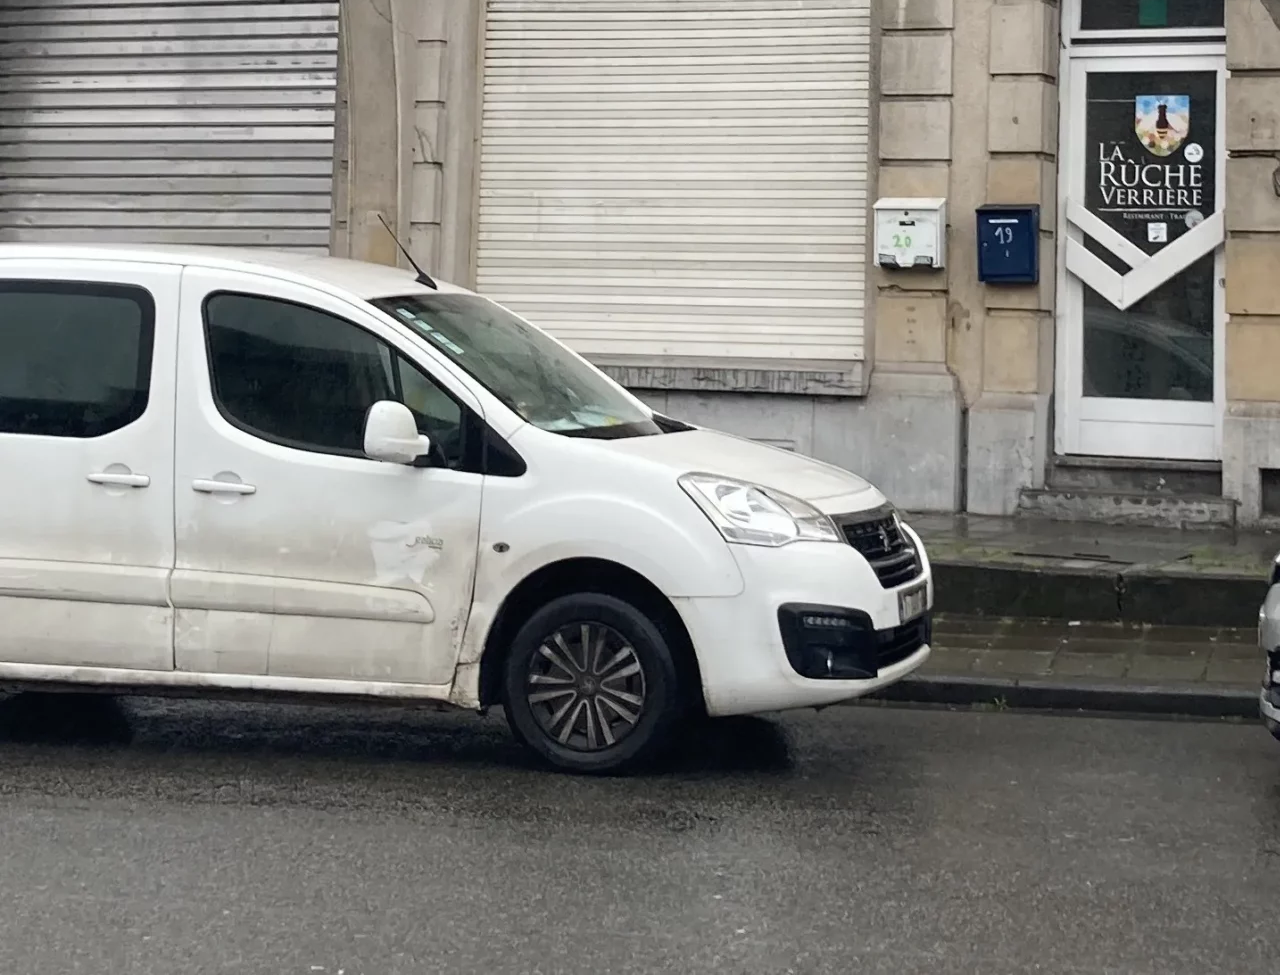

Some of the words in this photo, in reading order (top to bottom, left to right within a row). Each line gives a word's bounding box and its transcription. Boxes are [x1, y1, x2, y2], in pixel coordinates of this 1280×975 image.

[1099, 142, 1125, 161] LA
[1099, 184, 1202, 205] VERRIÈRE
[892, 233, 912, 249] 20
[994, 226, 1013, 245] 19
